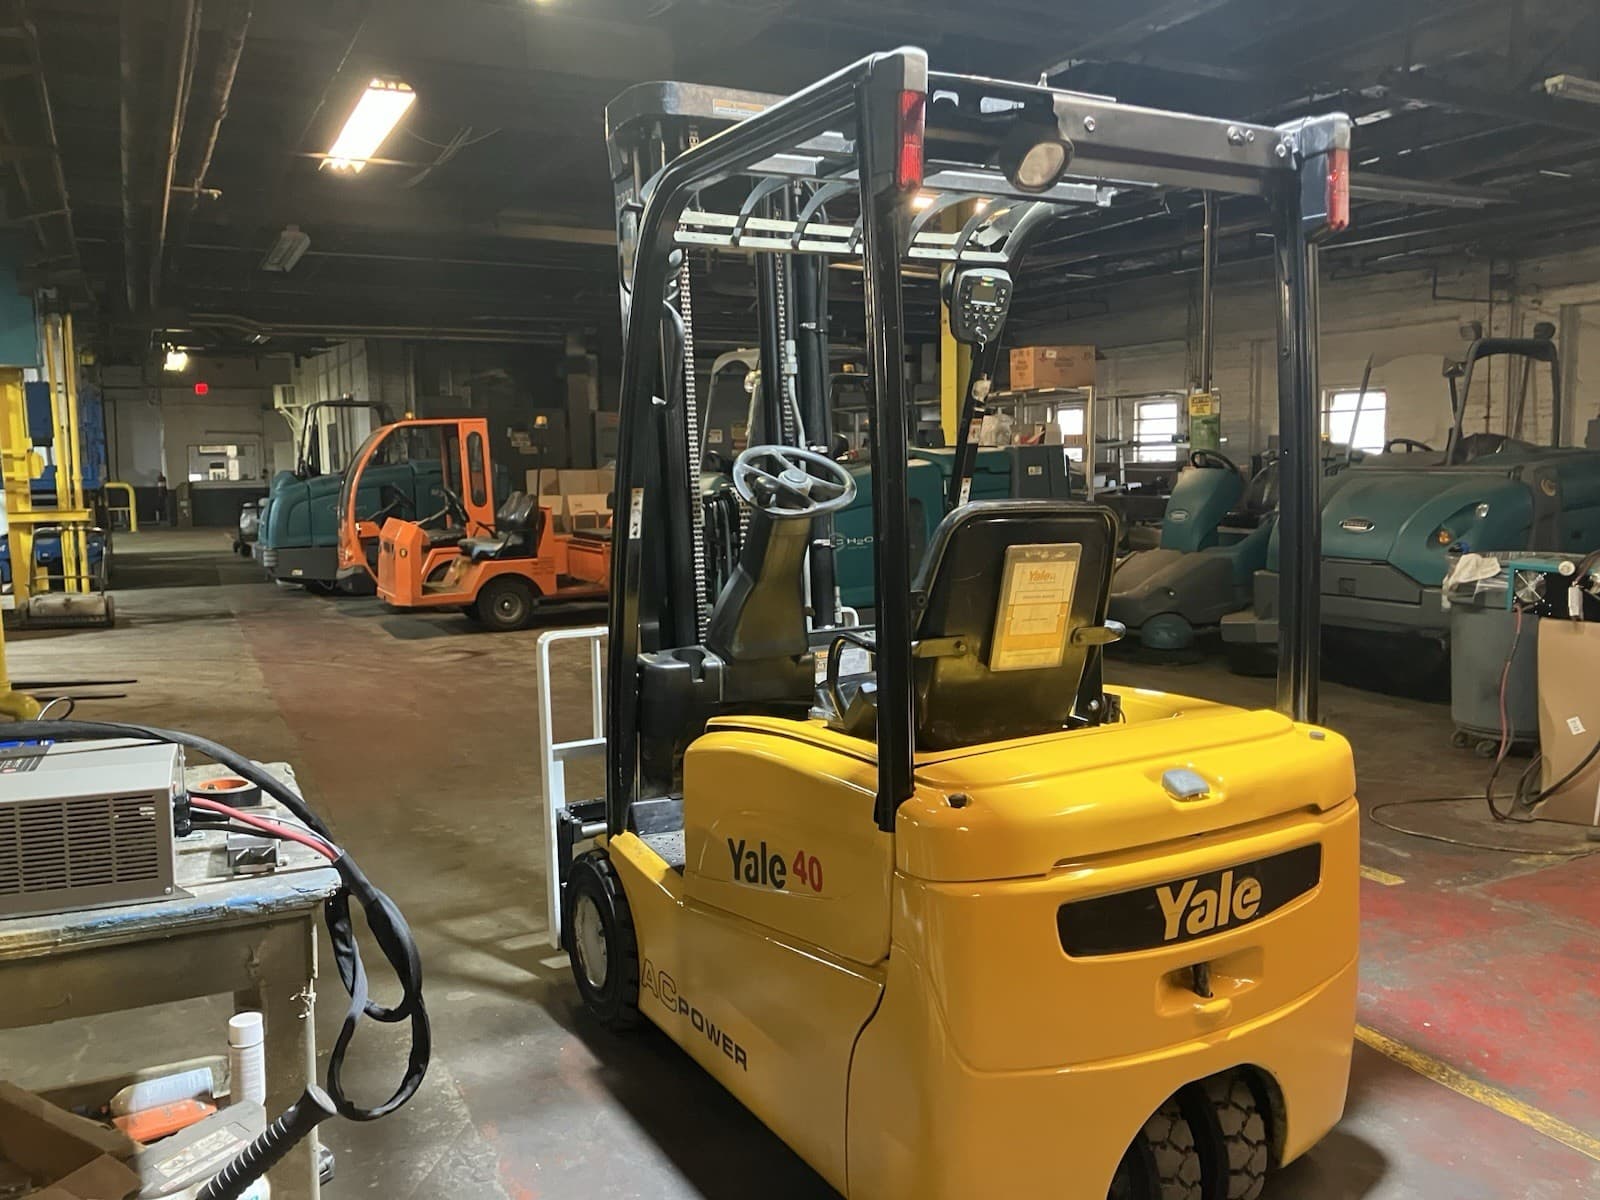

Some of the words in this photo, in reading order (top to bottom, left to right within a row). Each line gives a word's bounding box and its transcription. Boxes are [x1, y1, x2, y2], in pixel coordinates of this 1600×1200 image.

[727, 838, 787, 889] Yale
[793, 850, 823, 893] 40
[1155, 870, 1262, 941] Yale
